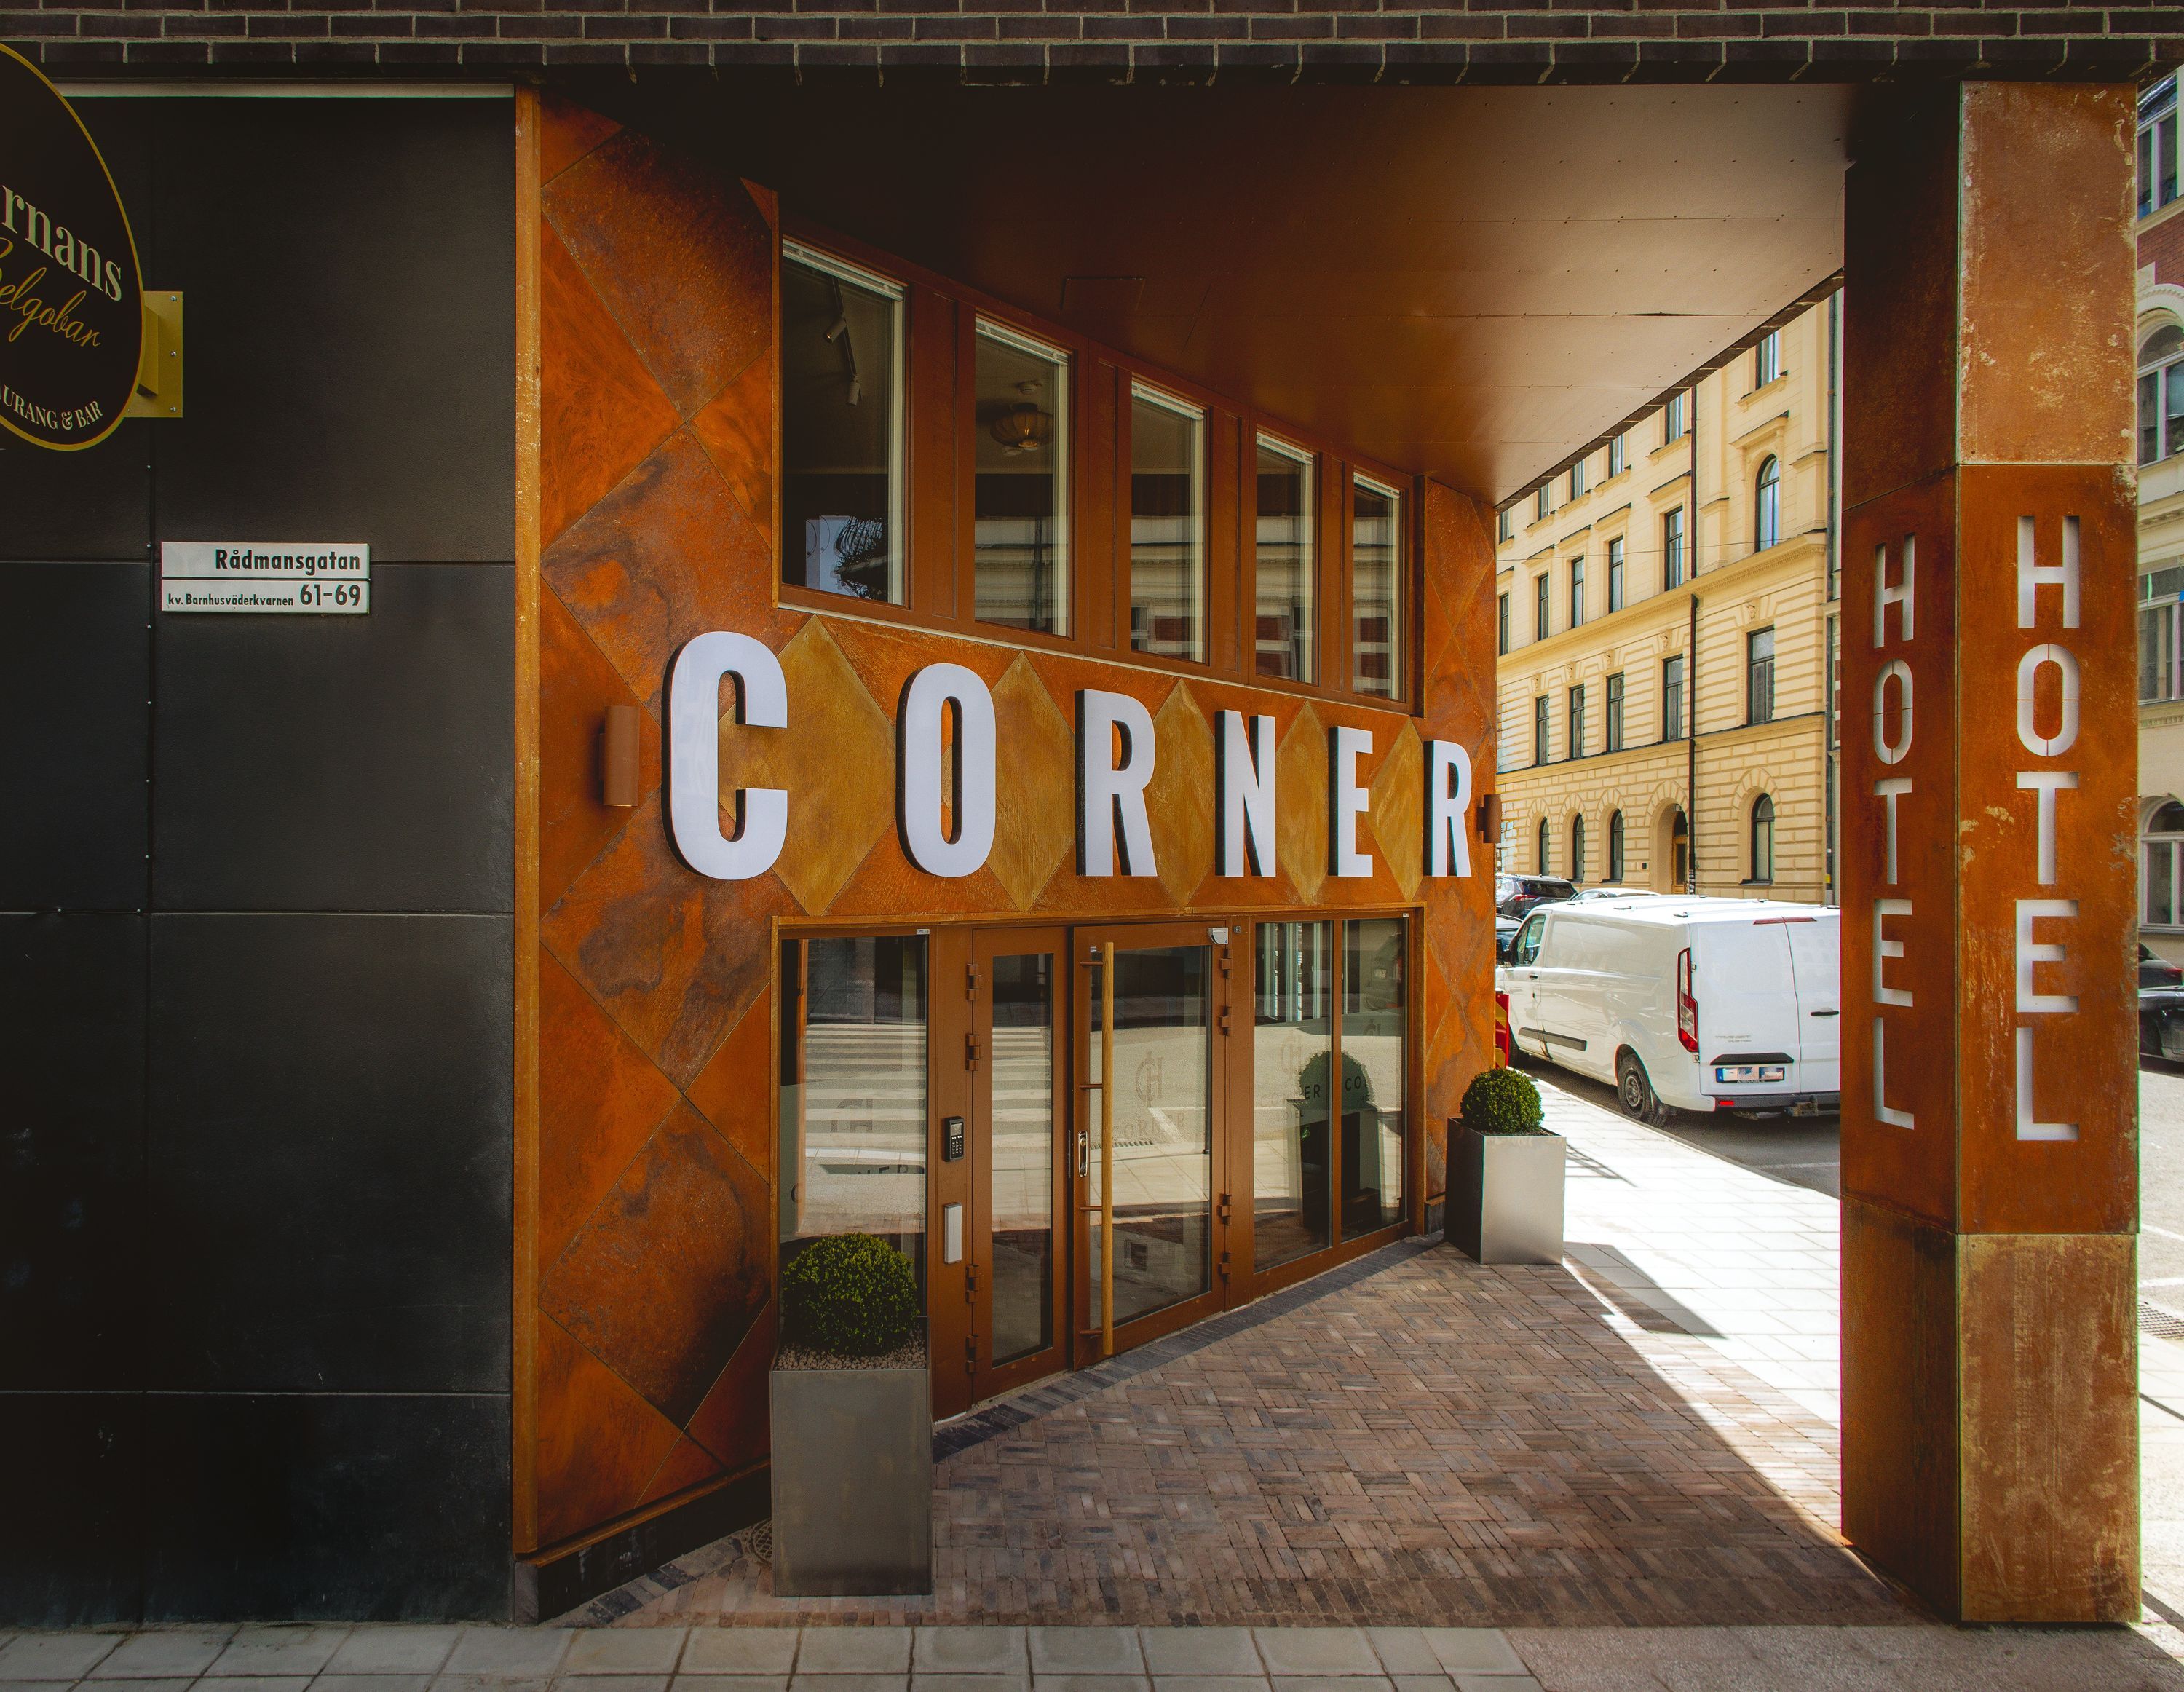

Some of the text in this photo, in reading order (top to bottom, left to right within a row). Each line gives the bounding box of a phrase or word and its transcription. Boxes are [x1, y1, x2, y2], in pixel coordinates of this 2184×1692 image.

[0, 237, 100, 347] elgobar
[61, 411, 74, 430] &
[75, 400, 103, 429] BAR
[167, 584, 361, 606] kv. Barnhusväderkvarnen 61-69
[215, 549, 360, 576] Rådmansgatan
[662, 630, 1471, 879] CORNER
[1874, 533, 1915, 1130] HOTEL
[2016, 515, 2081, 1141] HOTEL
